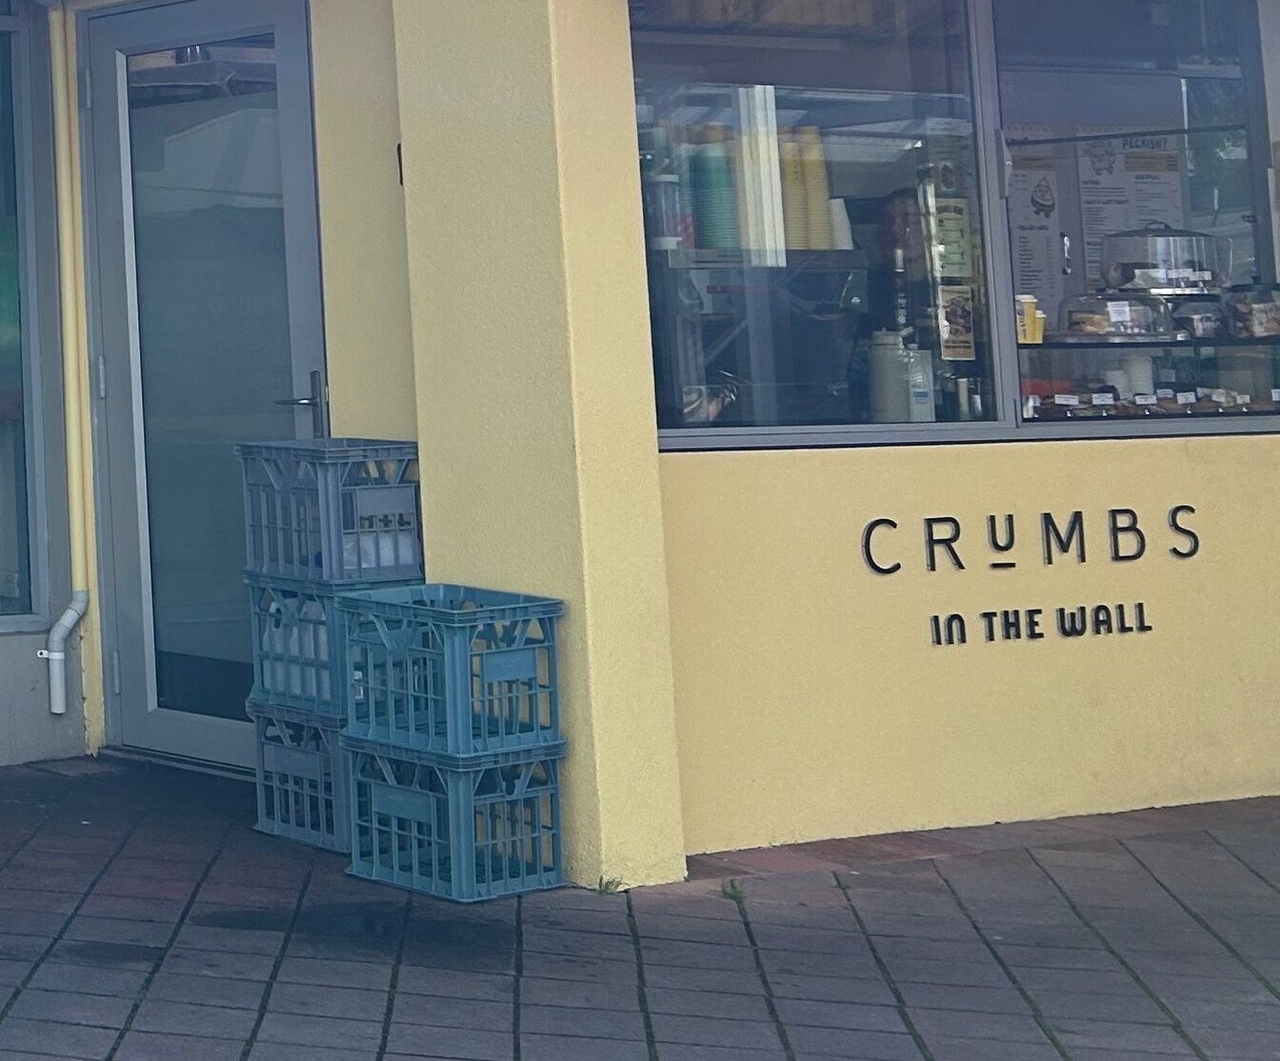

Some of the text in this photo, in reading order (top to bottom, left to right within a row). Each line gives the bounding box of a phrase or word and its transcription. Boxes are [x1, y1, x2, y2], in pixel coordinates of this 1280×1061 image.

[861, 505, 1201, 576] CRUMBS
[982, 608, 1045, 641] THE
[1056, 602, 1153, 637] WALL
